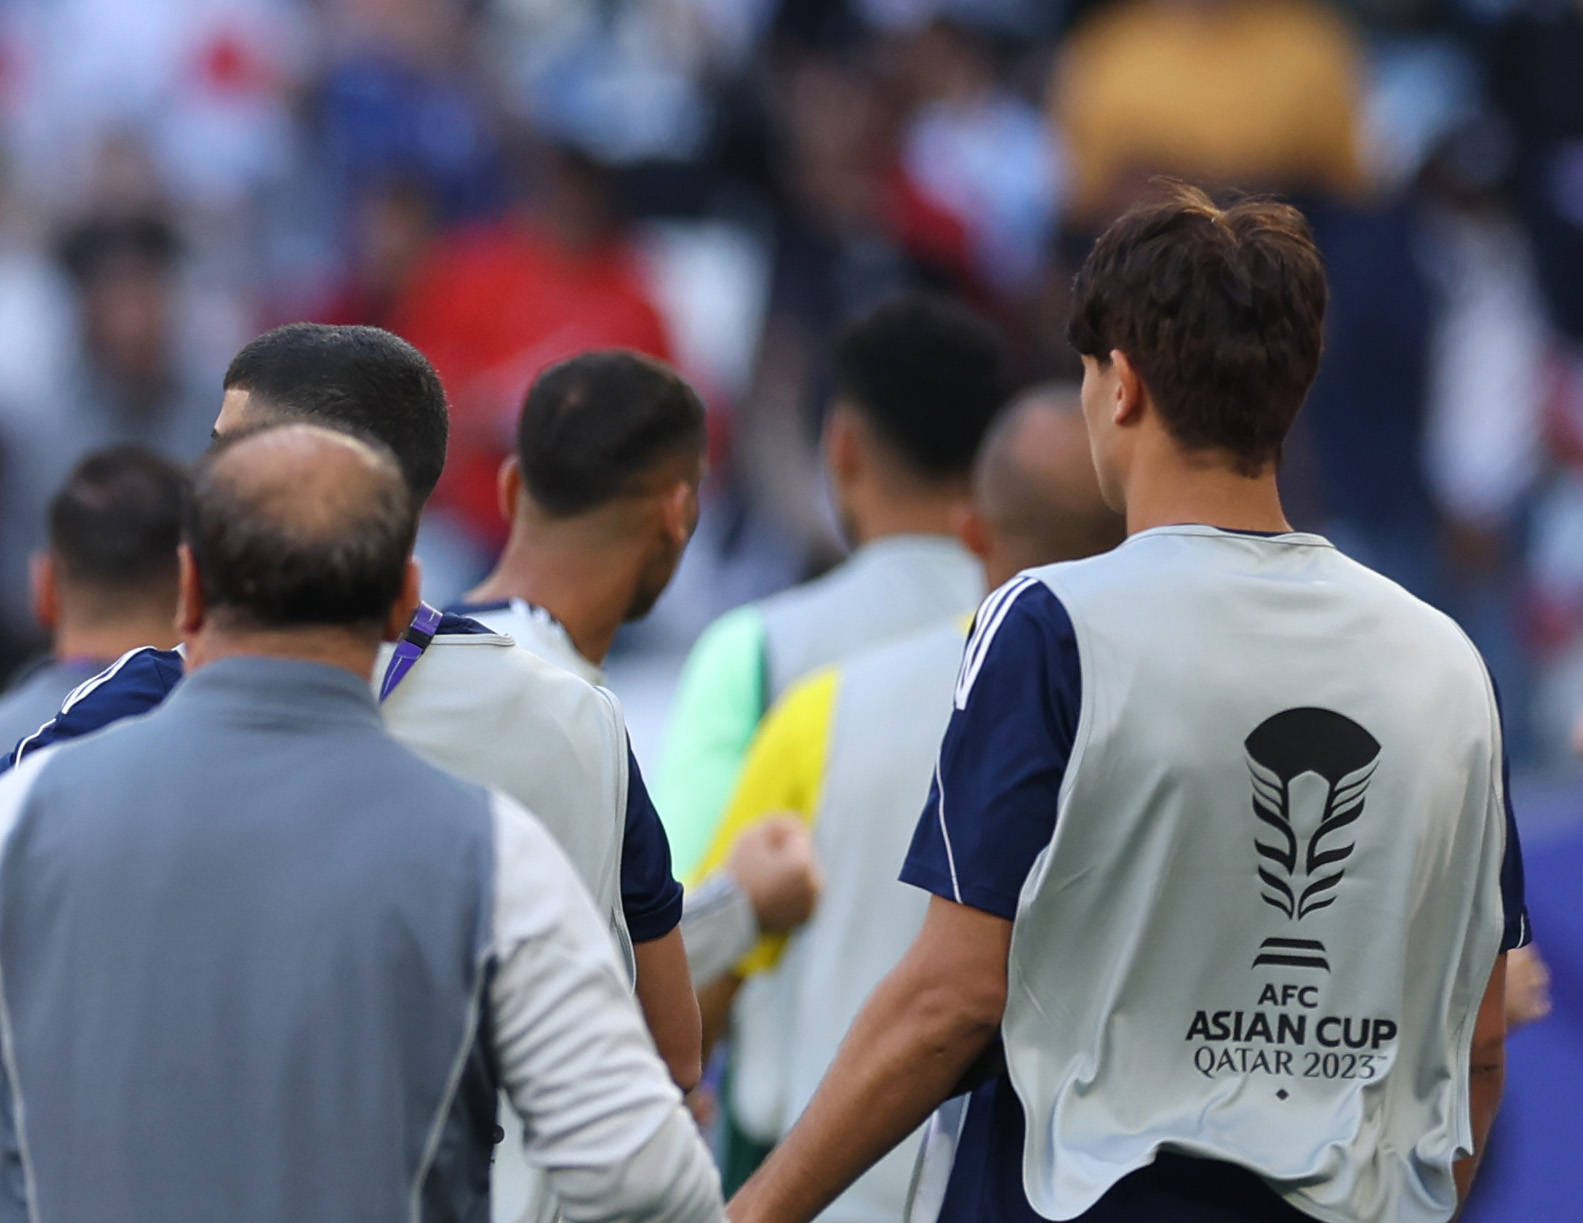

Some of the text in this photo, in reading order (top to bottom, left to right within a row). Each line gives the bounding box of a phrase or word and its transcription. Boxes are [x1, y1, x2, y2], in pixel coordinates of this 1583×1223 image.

[1258, 983, 1318, 1008] AFC
[1185, 1011, 1397, 1049] ASIAN CUP
[1194, 1046, 1294, 1078] QATAR
